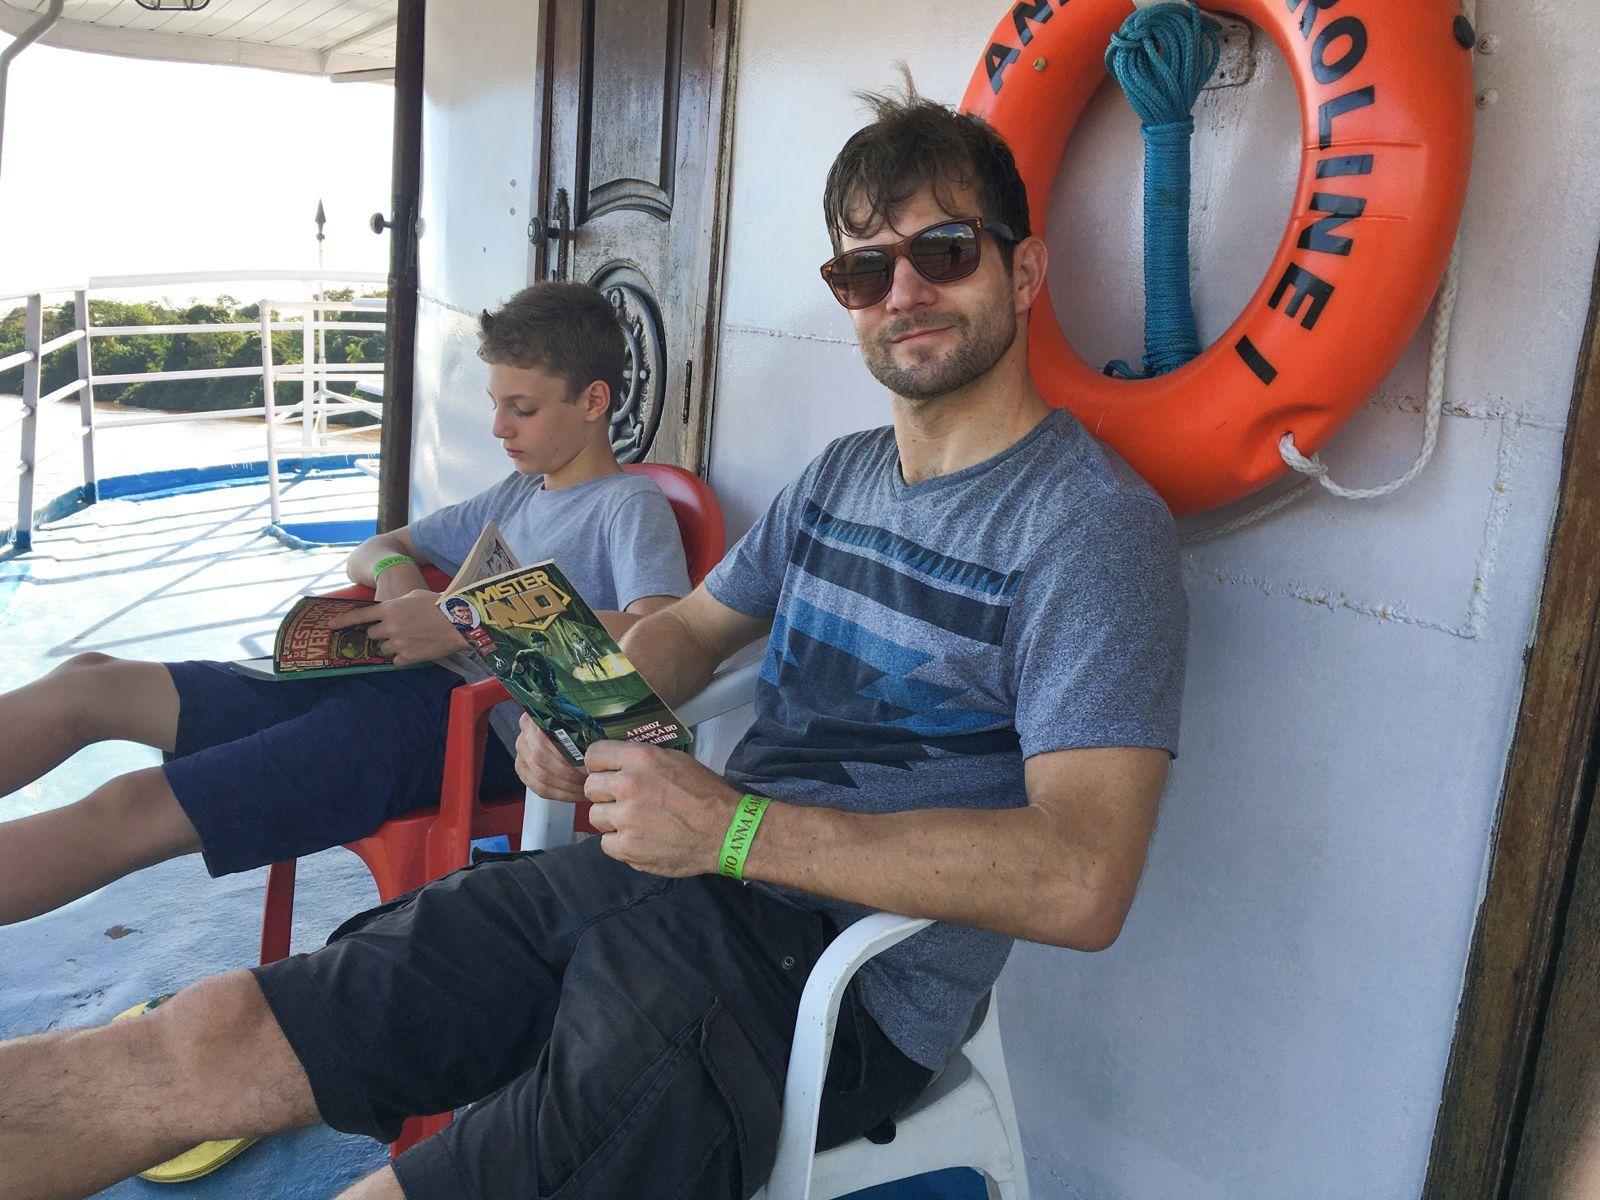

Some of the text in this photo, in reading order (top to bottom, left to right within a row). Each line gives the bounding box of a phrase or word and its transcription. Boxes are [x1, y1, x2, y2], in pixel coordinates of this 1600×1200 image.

[985, 0, 1070, 95] AN
[475, 570, 549, 605] MISTER
[485, 585, 568, 630] NO
[633, 721, 662, 735] FEROZ
[664, 724, 678, 732] DO
[730, 818, 753, 856] ANNA
